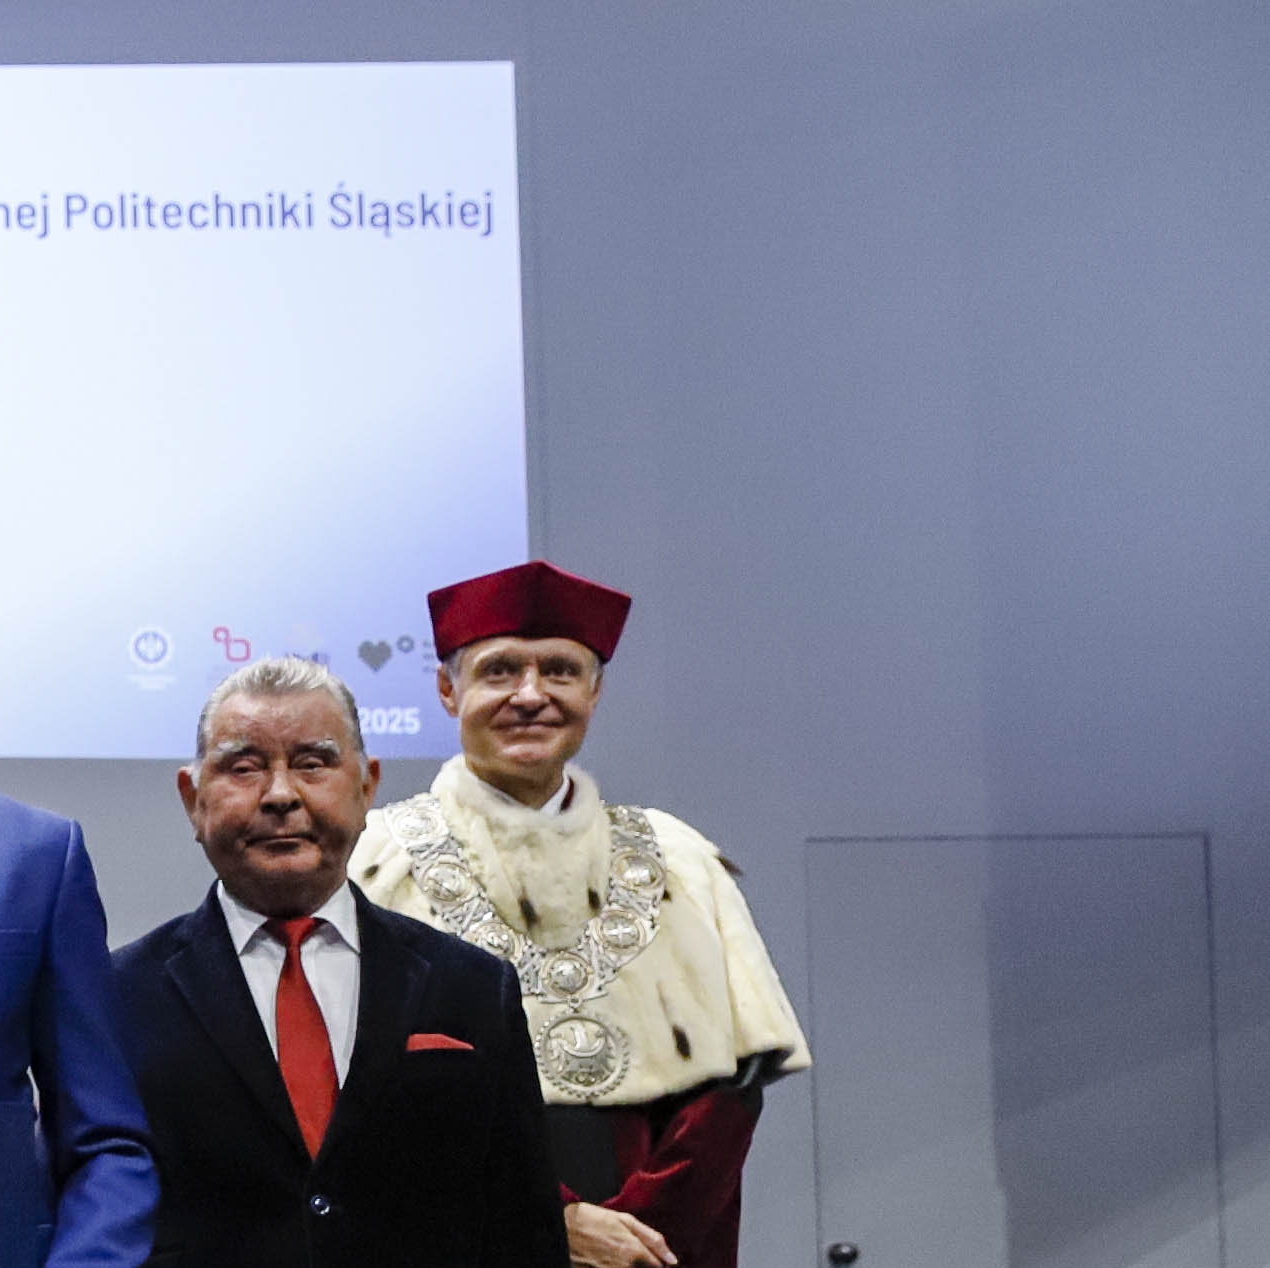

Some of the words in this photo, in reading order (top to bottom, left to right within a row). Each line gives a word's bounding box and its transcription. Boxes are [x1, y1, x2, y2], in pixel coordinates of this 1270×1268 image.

[64, 191, 314, 231] Politechniki
[328, 182, 494, 237] Śląskiej
[360, 707, 420, 734] 2025
